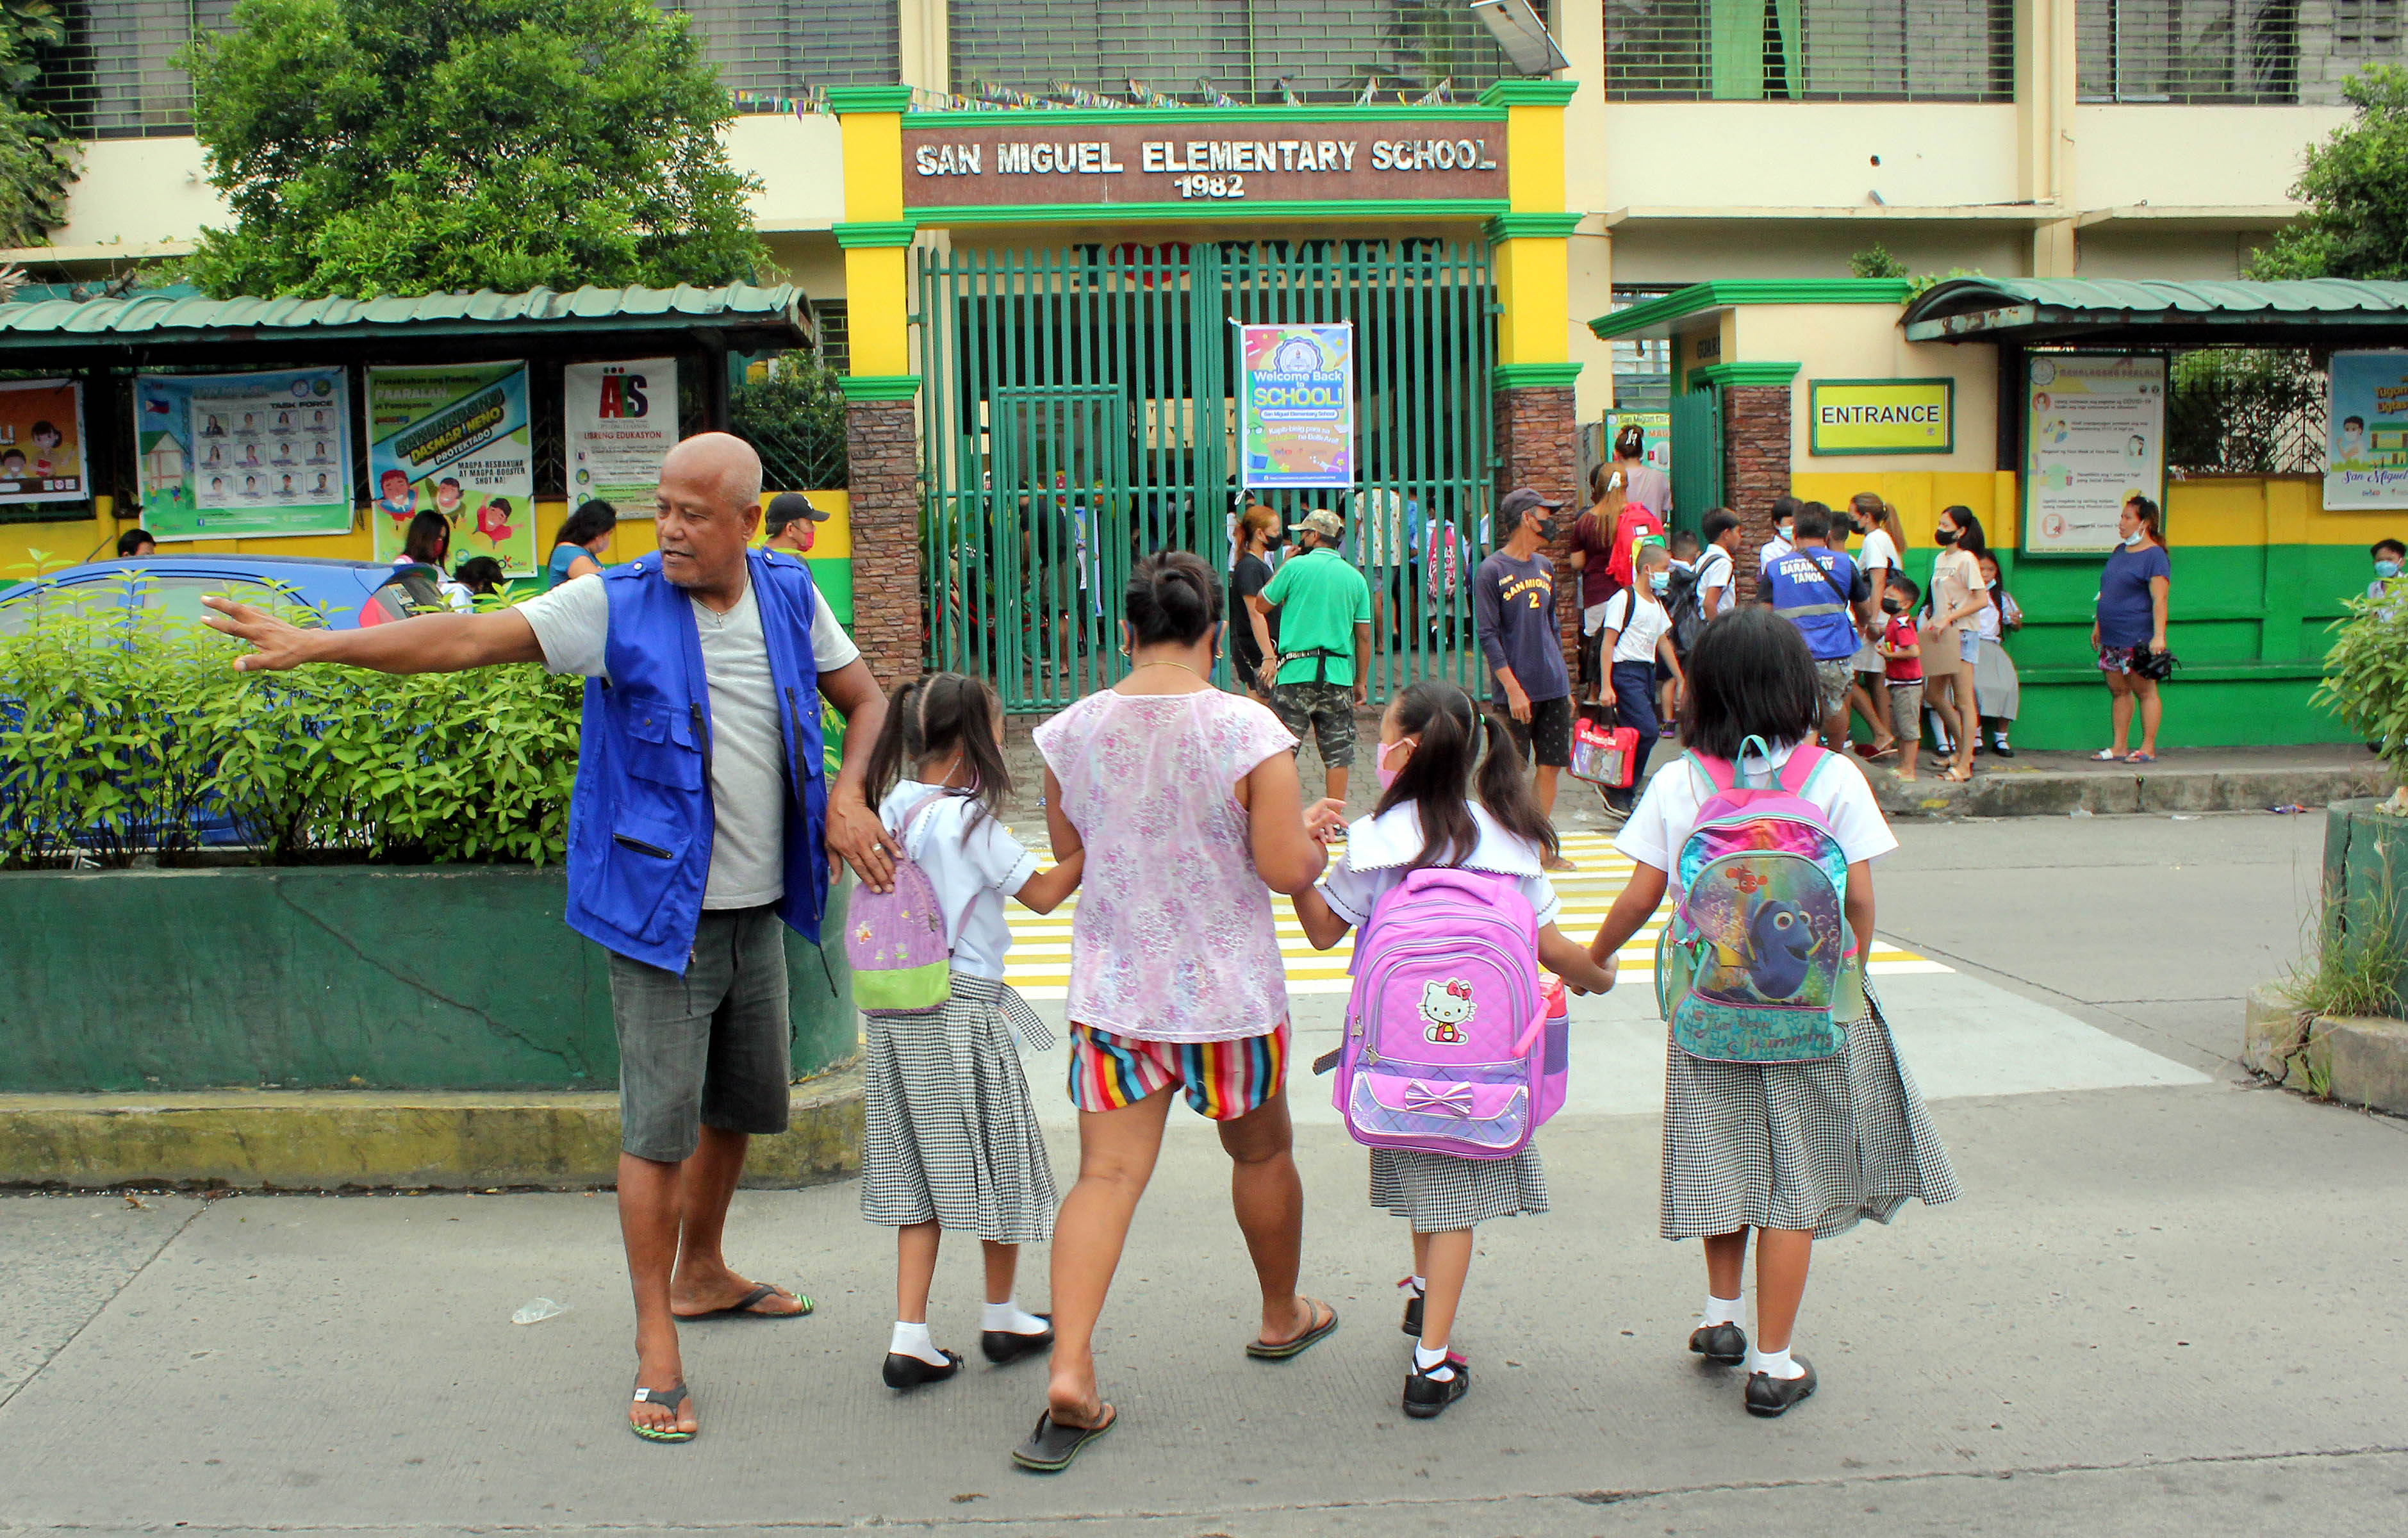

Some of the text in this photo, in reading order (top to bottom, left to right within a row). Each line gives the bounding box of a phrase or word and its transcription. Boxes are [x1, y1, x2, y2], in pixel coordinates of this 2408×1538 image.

[916, 138, 1496, 176] SAN MIGUEL ELEMENTARY SCHOOL
[1174, 174, 1245, 199] 1982
[1253, 370, 1342, 382] Welcome Back
[1253, 387, 1343, 406] SCHOOL!
[1821, 405, 1940, 424] ENTRANCE
[616, 431, 662, 439] EDUKASYON
[435, 428, 491, 464] PROTEKTADO
[2343, 469, 2408, 486] San Miguel
[1528, 591, 1541, 609] 2
